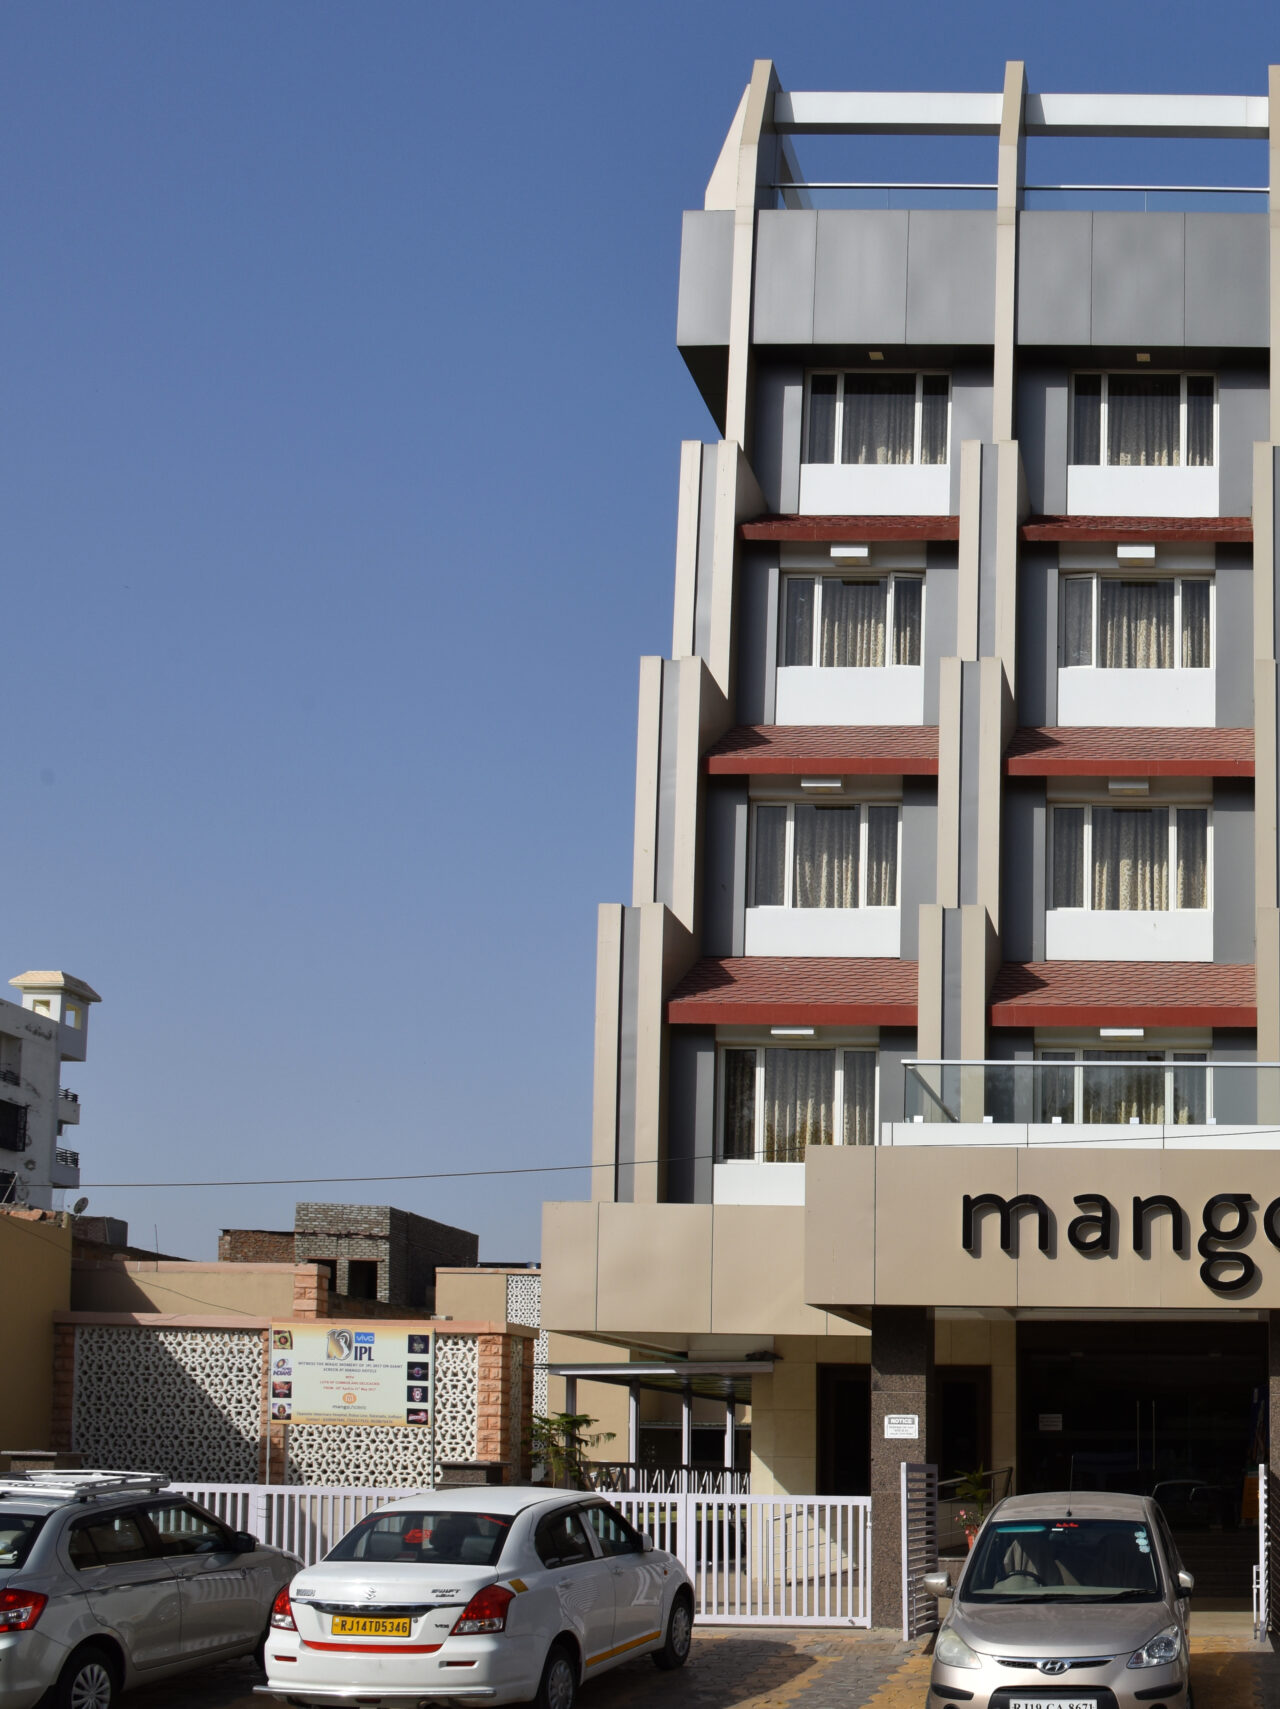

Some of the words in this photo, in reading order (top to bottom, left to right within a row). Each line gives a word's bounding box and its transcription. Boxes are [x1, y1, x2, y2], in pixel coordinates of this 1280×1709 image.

[356, 1334, 374, 1342] vivo
[354, 1346, 374, 1361] IPL
[340, 1619, 408, 1633] RJ14TD5346
